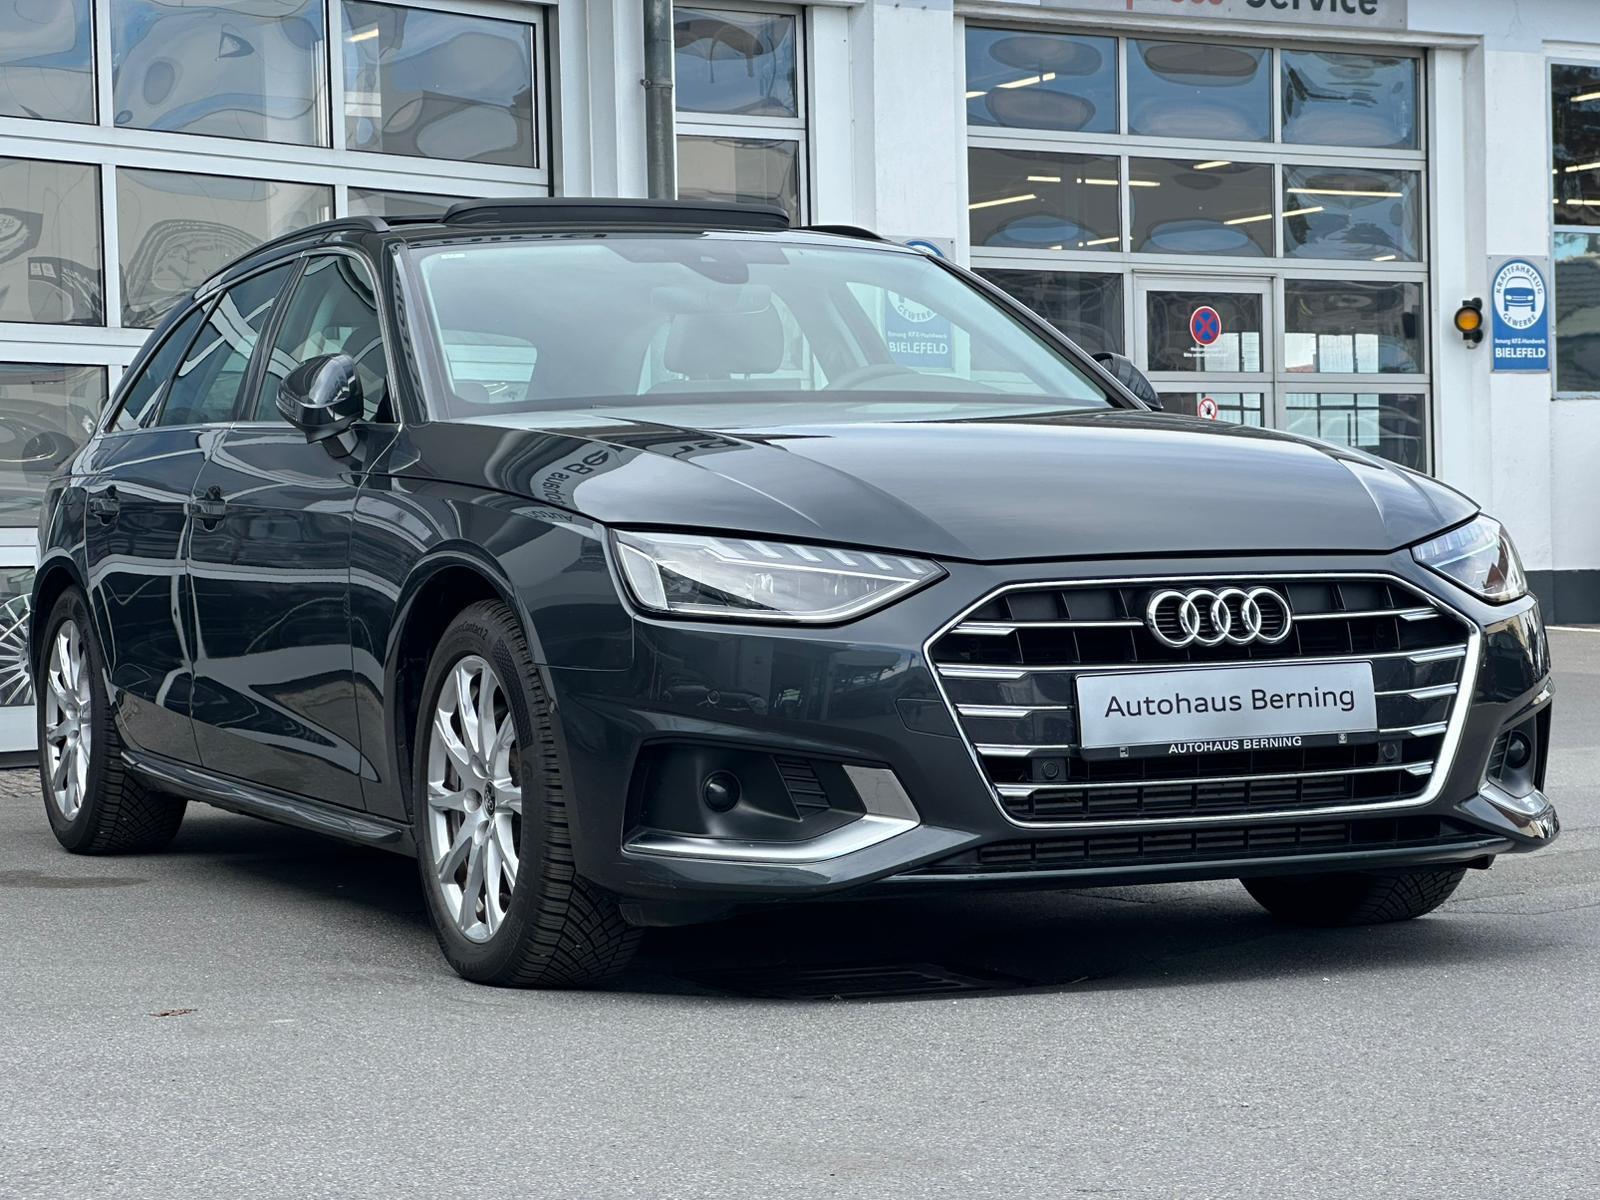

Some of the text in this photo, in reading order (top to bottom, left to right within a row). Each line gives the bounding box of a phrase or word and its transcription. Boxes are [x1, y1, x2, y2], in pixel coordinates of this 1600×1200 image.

[1496, 264, 1543, 294] KRAFTFAHRZEUG
[898, 304, 932, 320] GEWERB
[1503, 313, 1536, 327] GEWERBE
[888, 341, 948, 355] BIELEFELD
[1495, 347, 1546, 358] BIELEFELD
[1105, 686, 1355, 718] Autohaus Berning
[1168, 736, 1302, 754] AUTOHAUS BERNING
